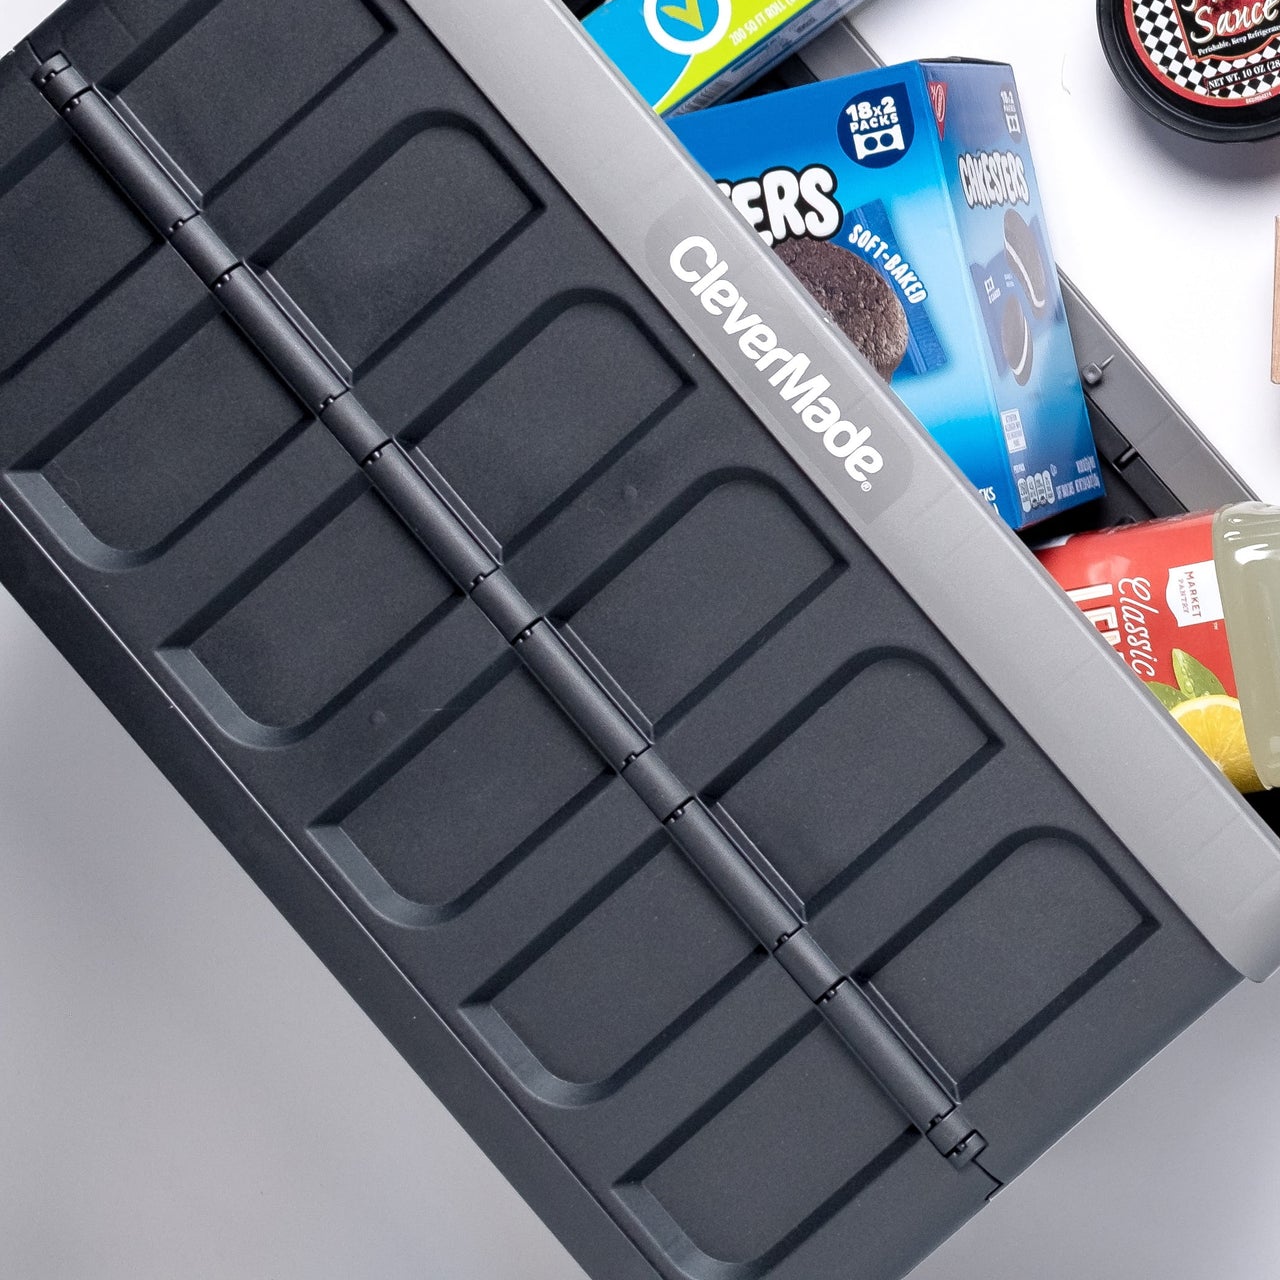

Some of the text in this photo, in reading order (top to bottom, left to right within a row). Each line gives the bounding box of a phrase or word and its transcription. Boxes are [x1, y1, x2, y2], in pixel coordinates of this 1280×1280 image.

[1197, 35, 1246, 55] Perishable, Keep
[1208, 64, 1265, 88] NET WT. 10 OZ
[846, 96, 896, 120] 18x2
[849, 112, 898, 132] PACKS
[958, 150, 1030, 209] CAKESTERS
[849, 224, 928, 304] SOFT-BAKED
[669, 235, 884, 483] CleverMade
[1178, 579, 1189, 613] PANTRY
[1184, 571, 1202, 617] MARKET
[1118, 577, 1160, 677] Classic
